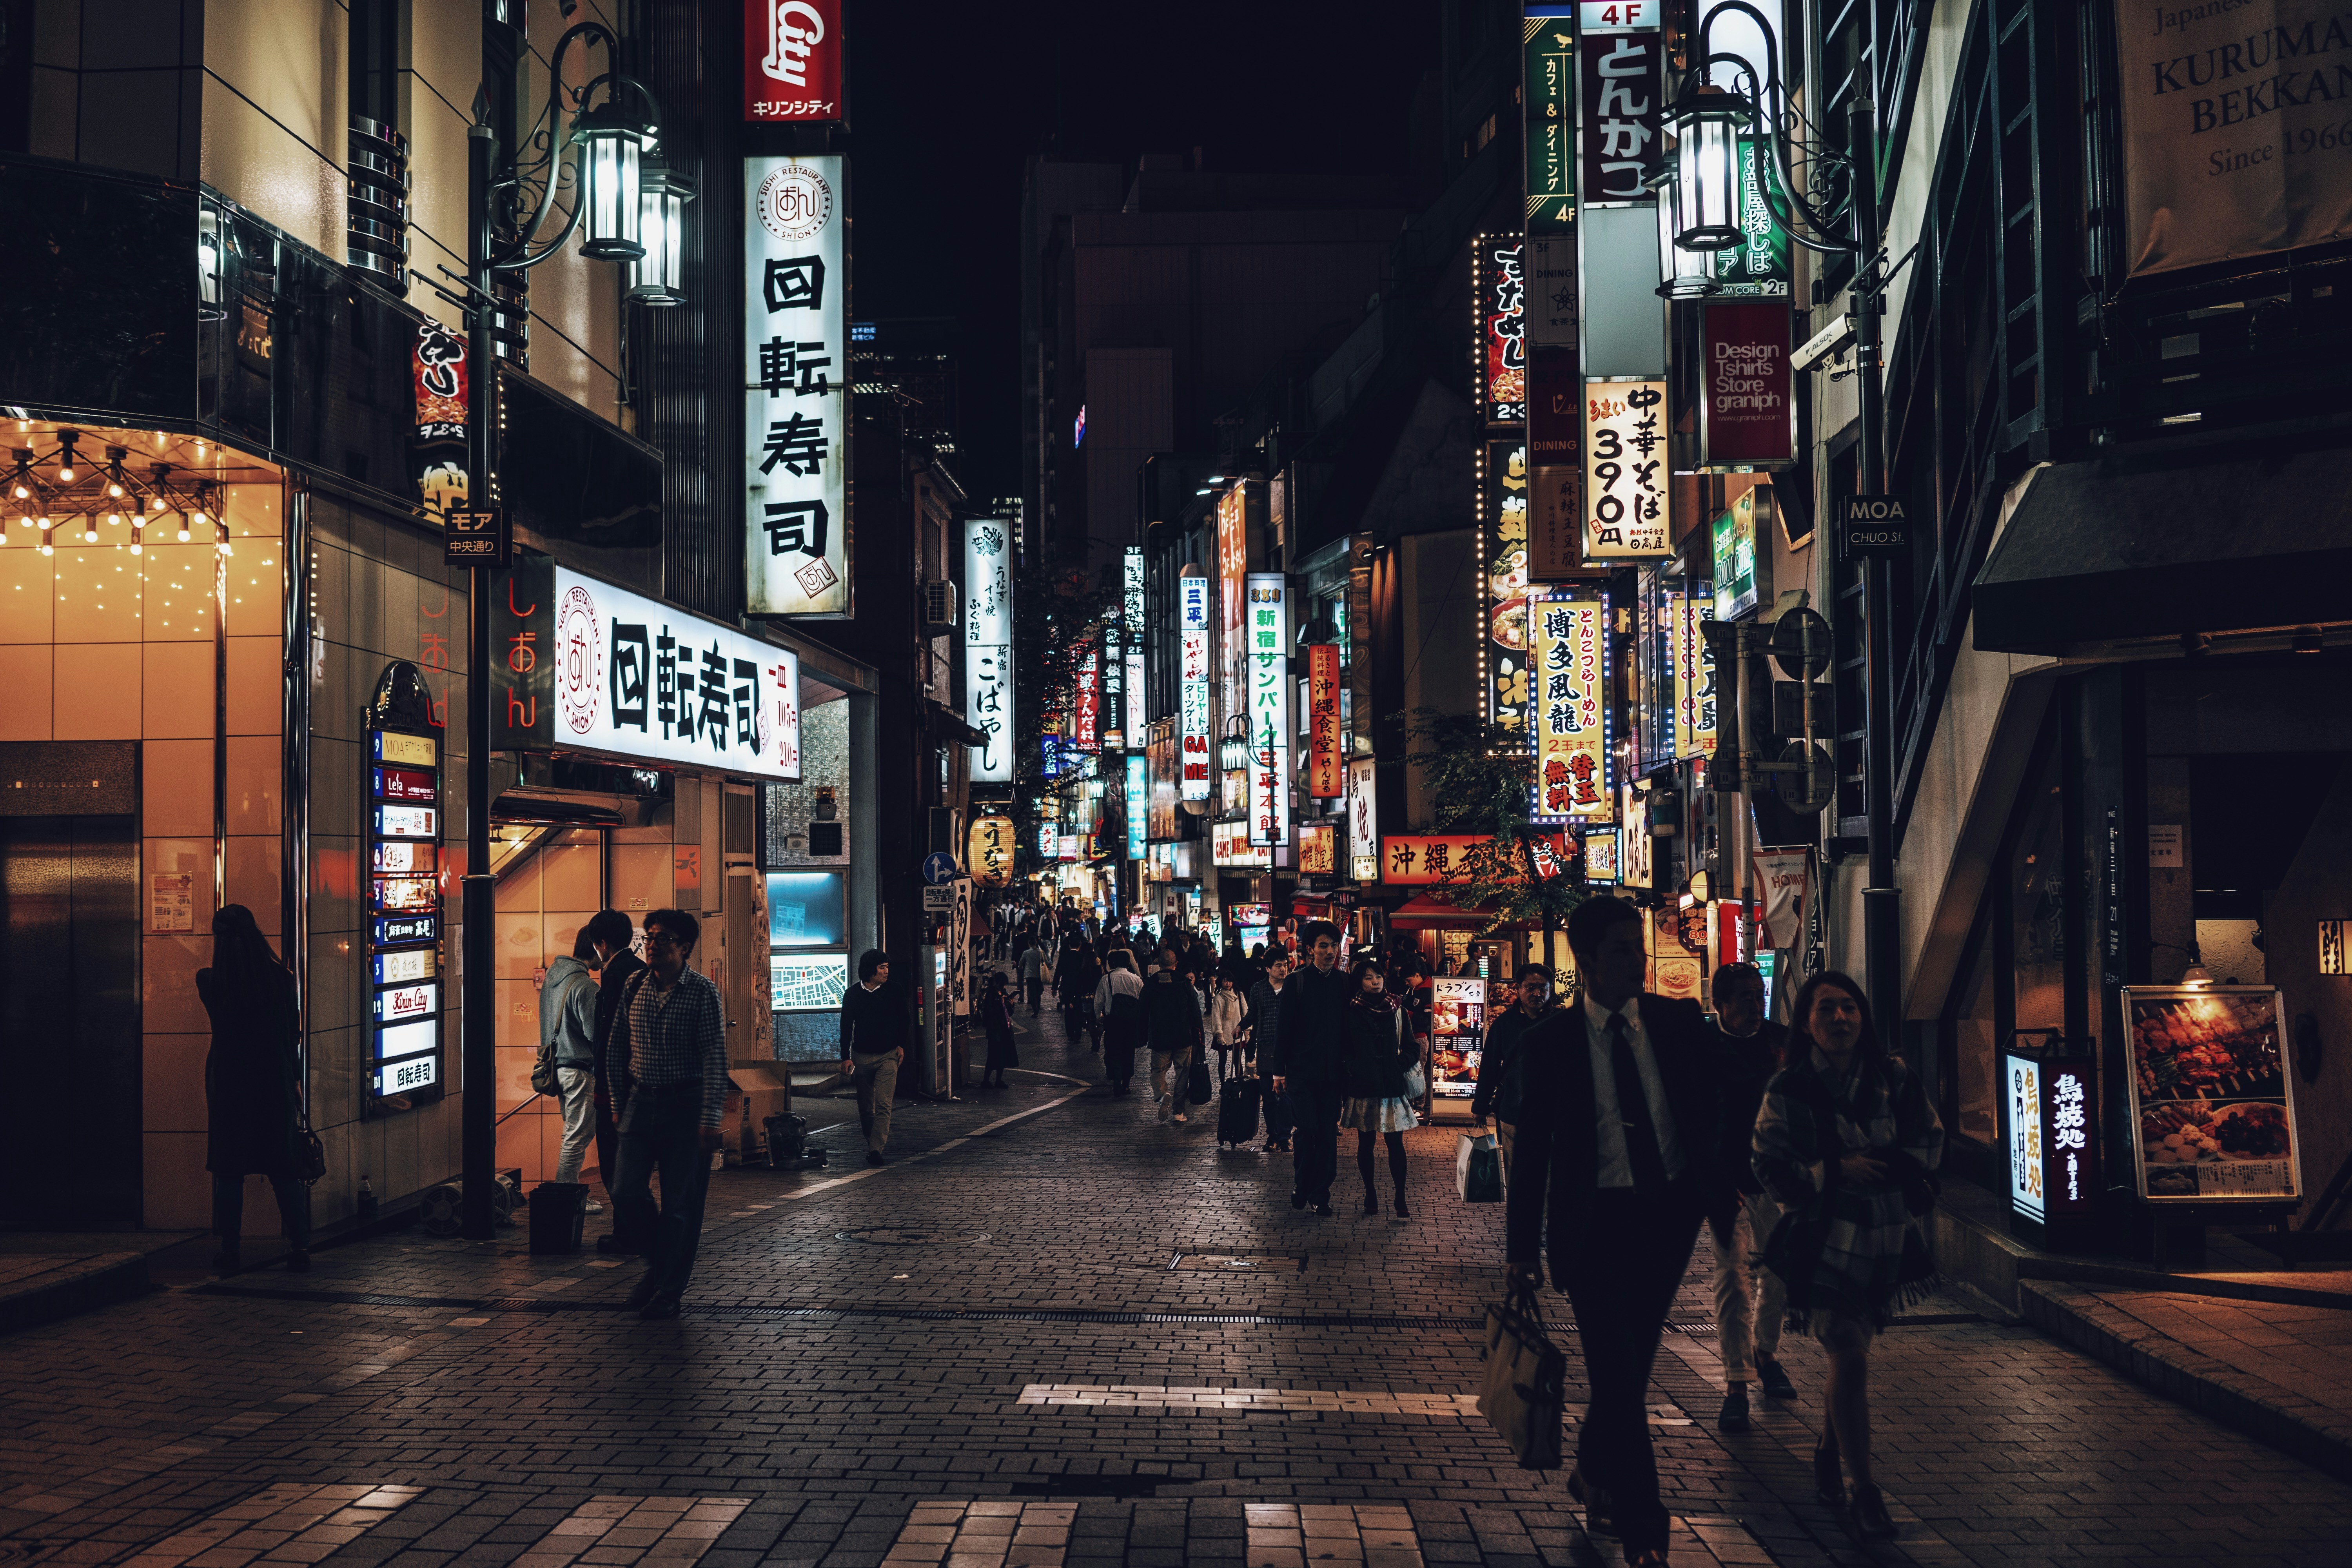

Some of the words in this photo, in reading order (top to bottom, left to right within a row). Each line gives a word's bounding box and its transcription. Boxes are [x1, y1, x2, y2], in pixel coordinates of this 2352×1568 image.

[1601, 4, 1641, 25] 4F
[1546, 58, 1556, 95] カフェ
[753, 100, 834, 116] キリンシティ
[1546, 103, 1557, 117] &
[1598, 38, 1652, 196] とんかつ
[1546, 124, 1559, 191] ダイニング
[2209, 145, 2273, 176] Since
[2283, 120, 2352, 155] 1966
[760, 174, 779, 196] SUSHI
[782, 167, 830, 195] RESTAURANT
[1555, 203, 1575, 222] 4F
[782, 231, 811, 239] SHION
[1536, 243, 1550, 252] 3F
[1536, 269, 1573, 278] DINING
[1735, 286, 1760, 294] CORE
[1767, 280, 1785, 294] 2F
[1715, 341, 1779, 362] Design
[1812, 331, 1833, 351] ALSOK
[1715, 359, 1774, 376] Tshirts
[1716, 376, 1764, 393] Store
[759, 254, 831, 557] 回転寿司
[1590, 399, 1626, 422] うまい
[1716, 391, 1780, 413] graniph
[1717, 414, 1780, 423] www.graniph.com
[1534, 441, 1577, 450] DINING
[1626, 385, 1666, 524] 中華そば
[1593, 429, 1624, 546] 390円
[1850, 501, 1905, 519] MOA
[452, 514, 493, 530] モア
[1559, 481, 1577, 568] 麻辣王豆腐
[450, 540, 494, 552] 中央通り
[1630, 537, 1665, 550] 日高屋
[1851, 532, 1887, 543] CHUO
[1891, 532, 1904, 542] St.
[996, 566, 1008, 602] うなぎ
[984, 584, 996, 617] すき焼
[1187, 589, 1202, 622] 三平
[558, 600, 570, 632] SUSHI
[572, 591, 600, 645] RESTAURANT
[969, 599, 980, 641] ふぐ料理
[508, 577, 536, 728] しおん
[997, 646, 1007, 671] 新宿
[768, 665, 787, 689] 一皿
[1256, 609, 1278, 746] 新宿サンパーク
[1544, 608, 1583, 734] 博多風龍
[1580, 610, 1596, 727] とんこつらーめん
[610, 617, 760, 757] 回転寿司
[778, 701, 797, 730] 105円
[1127, 668, 1138, 744] SANPEI
[1185, 684, 1195, 732] ダーツゲーム
[1196, 685, 1206, 726] ビリヤード
[1315, 679, 1335, 753] 沖縄食堂
[571, 714, 589, 728] SHION
[375, 739, 379, 752] 9
[385, 740, 404, 756] MOA
[779, 740, 798, 769] 210円
[1184, 736, 1207, 753] GA
[1548, 739, 1596, 752] 2玉まで
[375, 776, 379, 789] 8
[1184, 763, 1208, 780] ME
[1321, 758, 1332, 793] やんばる
[1568, 753, 1601, 806] 替玉
[1129, 784, 1145, 792] 100
[1258, 751, 1279, 831] 三平本館
[1544, 759, 1573, 813] 無料
[375, 812, 379, 827] 7
[374, 849, 380, 865] 6
[983, 822, 1004, 882] うなぎ
[1216, 841, 1229, 858] GAME
[1300, 844, 1326, 869] 沖縄食堂
[376, 888, 379, 900] 5
[375, 926, 379, 938] 4
[376, 964, 379, 976] 3
[1436, 981, 1473, 995] ドラゴン
[374, 1076, 381, 1089] B1
[397, 1062, 430, 1088] 回転寿司
[2052, 1074, 2085, 1149] 鳥焼処
[2025, 1067, 2042, 1199] 鳥焼処
